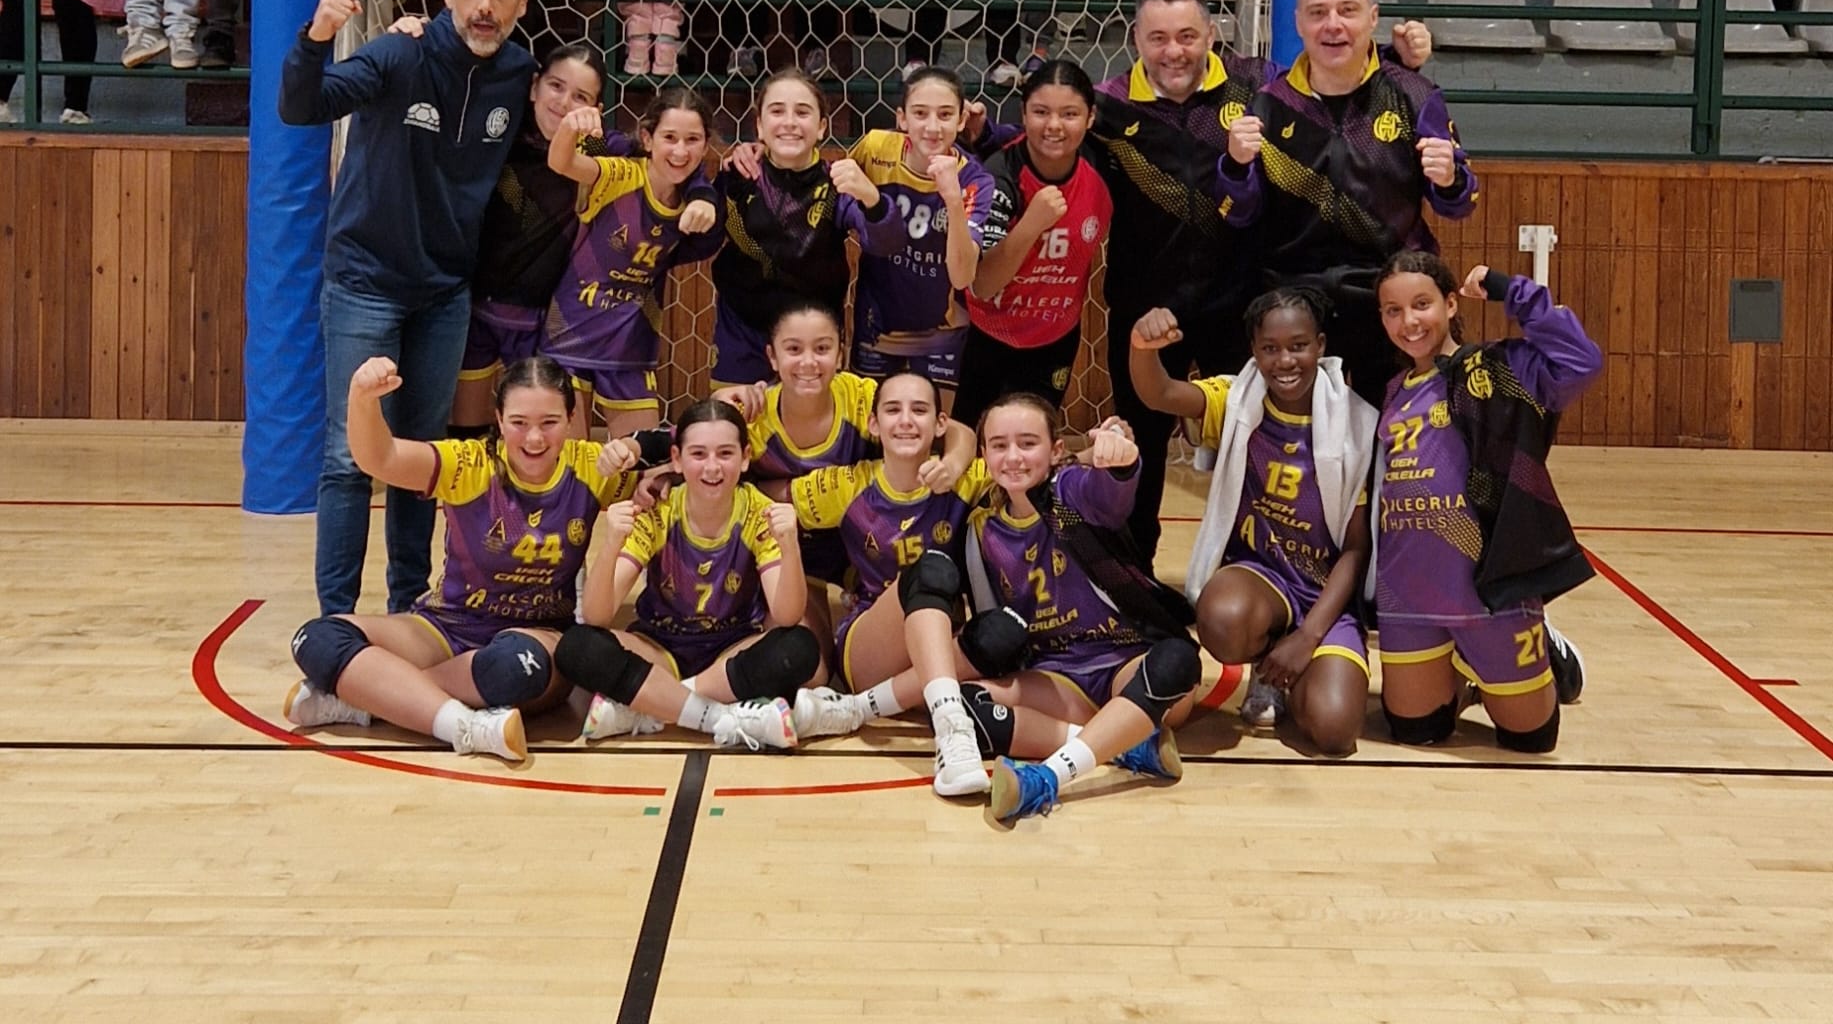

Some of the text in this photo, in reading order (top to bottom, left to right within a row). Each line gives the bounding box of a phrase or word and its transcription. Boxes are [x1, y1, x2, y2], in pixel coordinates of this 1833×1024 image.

[871, 157, 897, 170] Kempa
[631, 241, 662, 268] 14
[1038, 227, 1069, 259] 16
[889, 254, 937, 277] OTELS
[1032, 265, 1065, 275] UEH
[1013, 275, 1078, 285] CALELLA
[928, 364, 954, 376] Kempa
[1463, 349, 1483, 373] 27
[1389, 416, 1424, 454] 27
[1390, 457, 1418, 468] UEH
[1265, 461, 1303, 500] 13
[804, 480, 821, 523] CALELLA
[1260, 496, 1297, 515] UEH
[1390, 516, 1448, 530] HOTELS
[512, 533, 564, 564] 44
[892, 535, 924, 566] 15
[1028, 567, 1051, 603] 2
[695, 583, 713, 614] 7
[1029, 608, 1079, 632] CALELLA
[1514, 622, 1545, 667] 27
